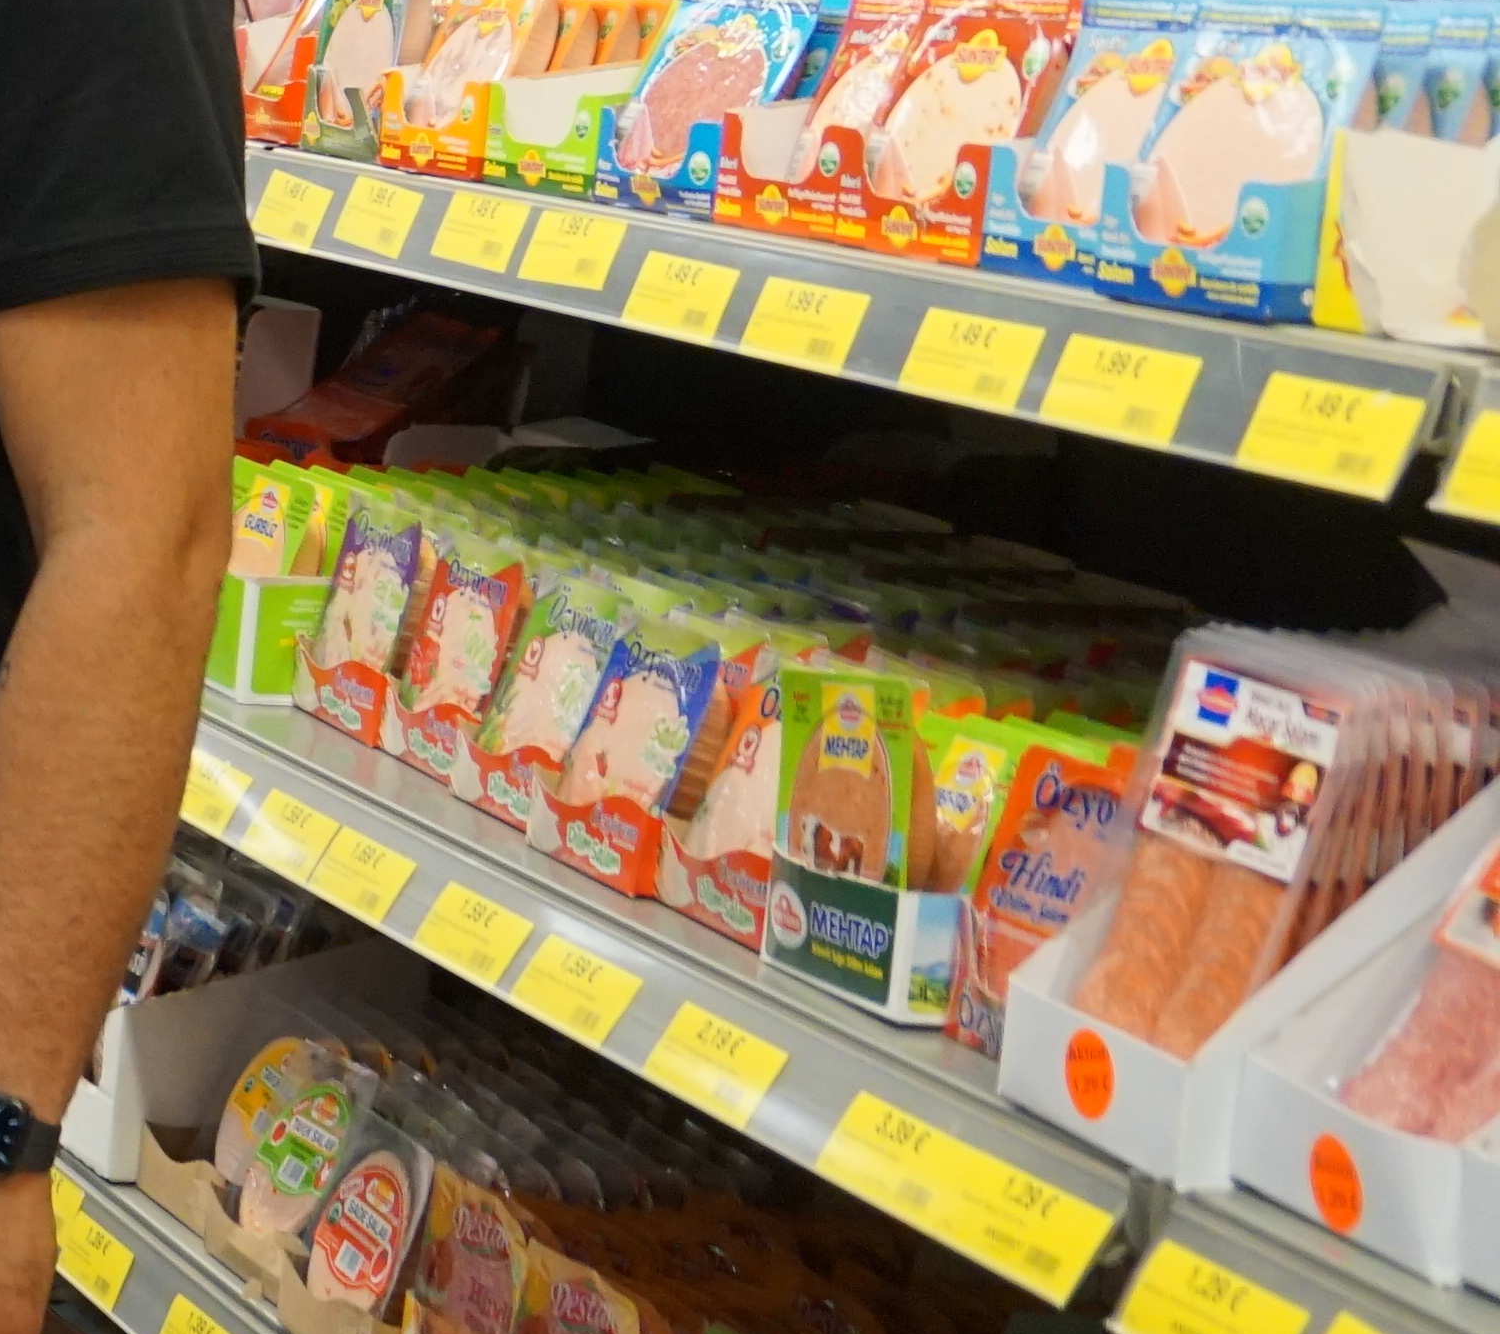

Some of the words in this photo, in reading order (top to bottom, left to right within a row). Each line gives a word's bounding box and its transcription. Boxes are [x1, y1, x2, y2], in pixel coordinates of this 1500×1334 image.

[823, 734, 870, 761] MEHTAP
[1000, 849, 1086, 904] Hindi
[810, 903, 889, 960] MEHTAP
